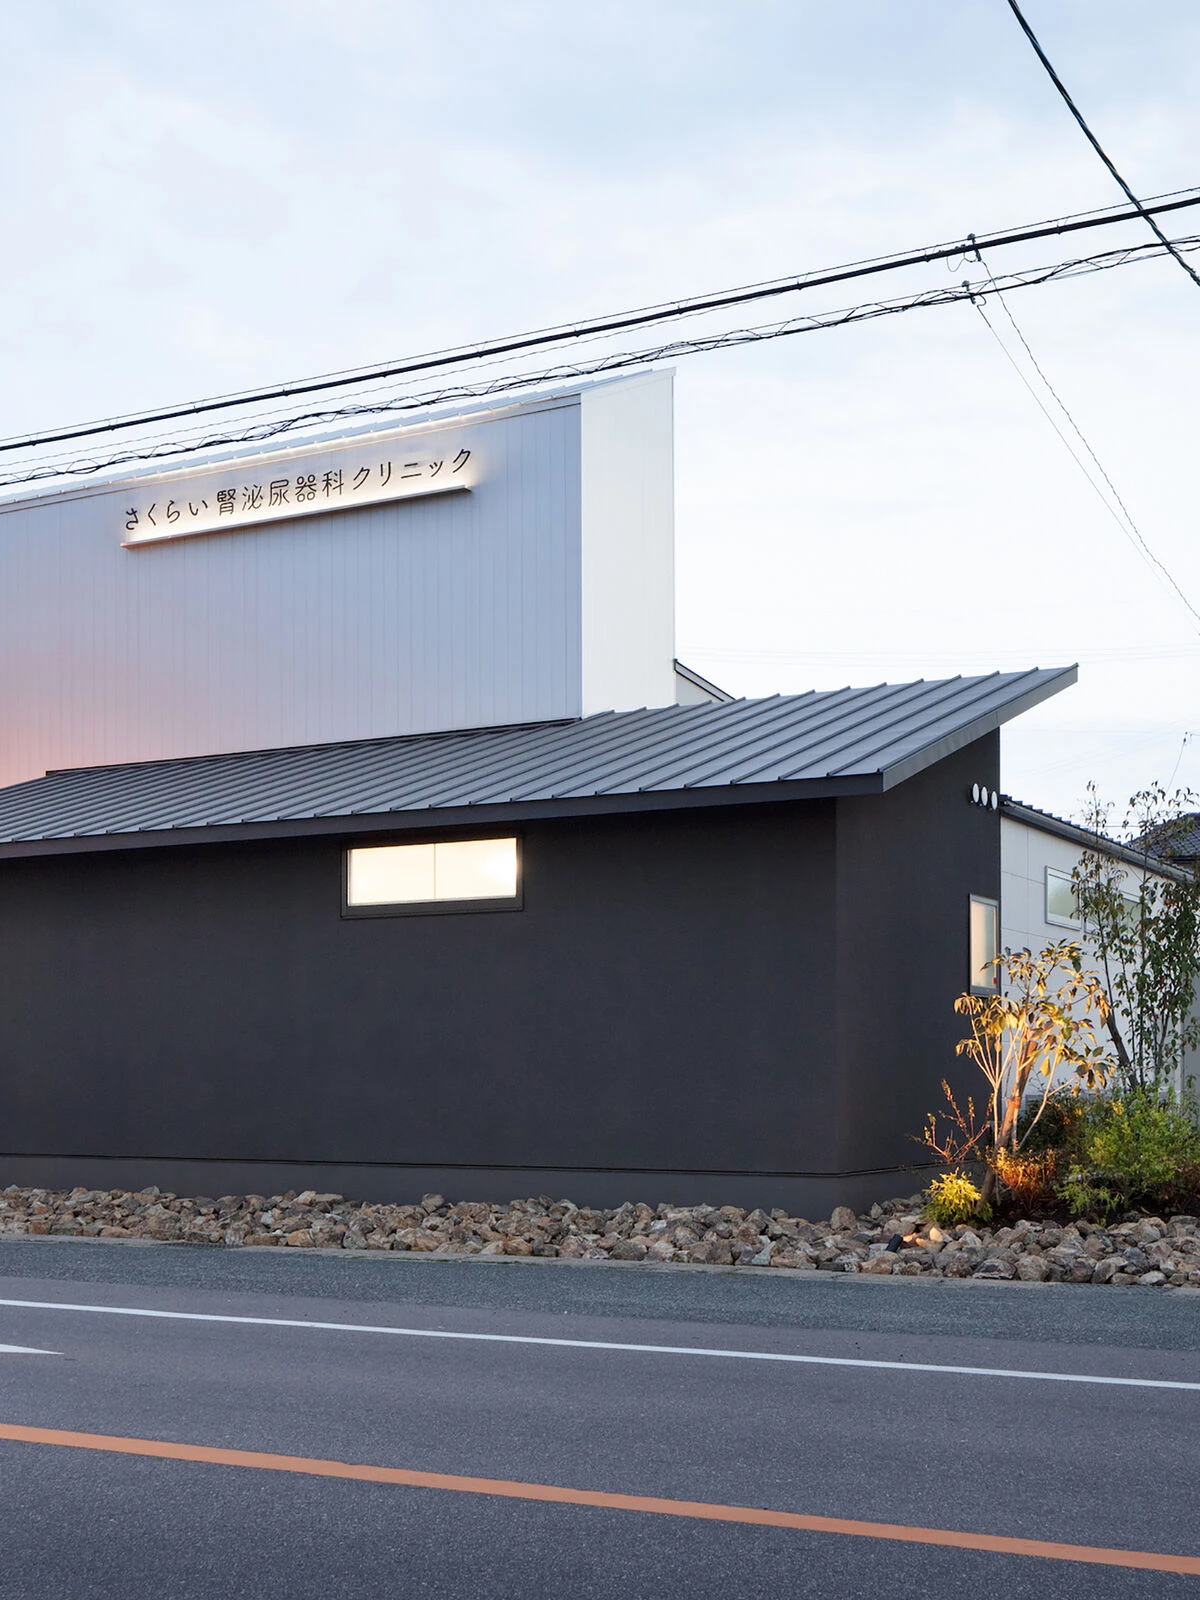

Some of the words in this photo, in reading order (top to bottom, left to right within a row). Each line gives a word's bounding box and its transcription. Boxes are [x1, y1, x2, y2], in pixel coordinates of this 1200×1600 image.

[125, 448, 472, 531] さくらい腎泌尿器科クリニック
